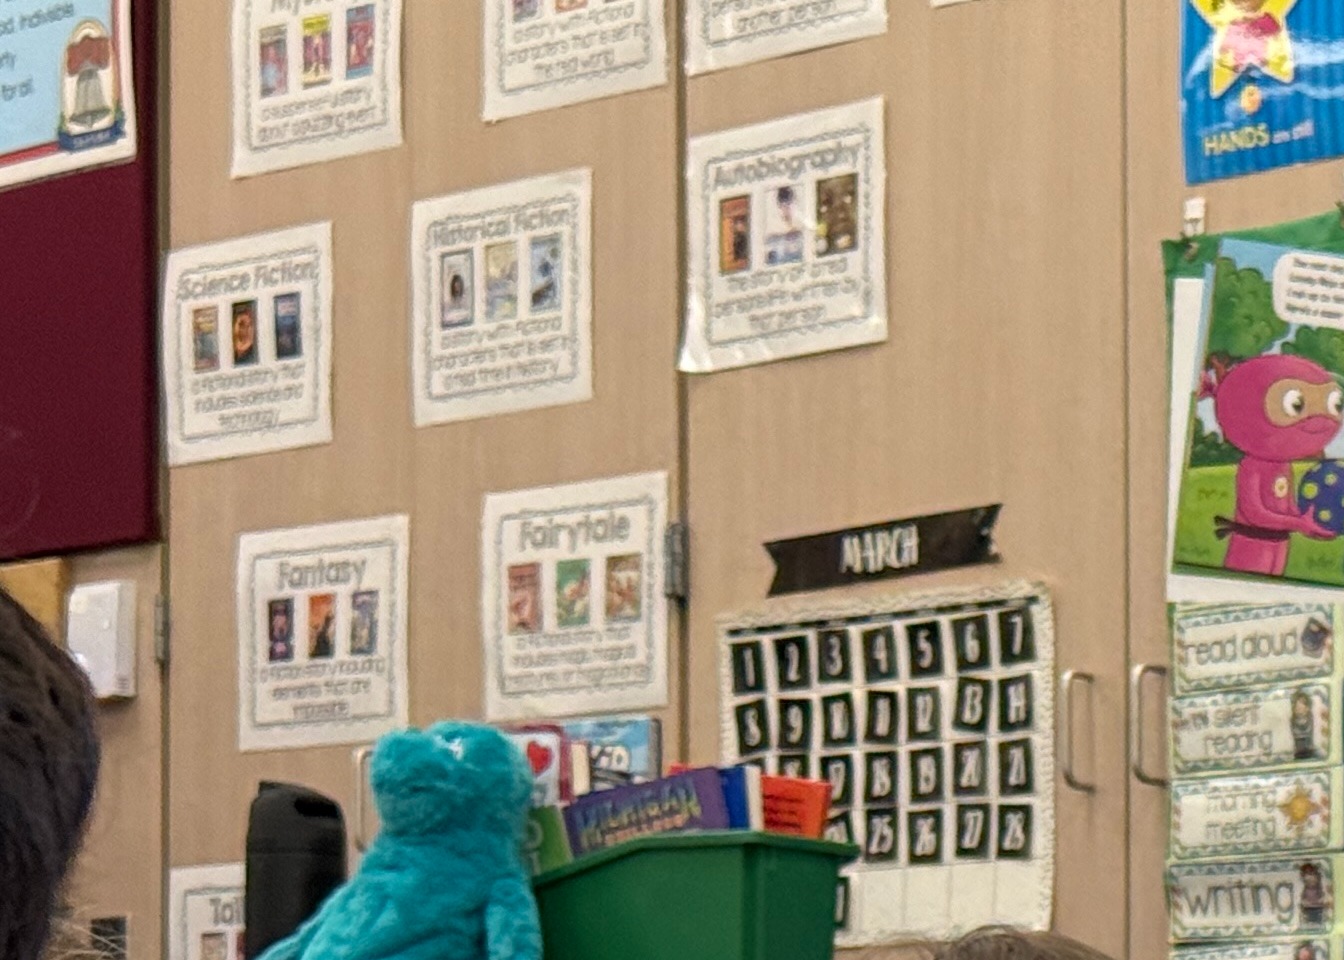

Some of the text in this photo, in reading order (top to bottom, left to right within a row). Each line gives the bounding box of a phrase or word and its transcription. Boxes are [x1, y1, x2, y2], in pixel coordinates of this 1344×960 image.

[1203, 121, 1271, 157] HANDS
[713, 141, 860, 190] Autobiography
[432, 204, 573, 248] Historical Fiction
[178, 258, 319, 298] Science Fiction
[519, 511, 633, 554] Fairytale
[839, 522, 920, 575] MARCH
[277, 557, 368, 592] Fantasy
[742, 646, 756, 688] 1
[785, 642, 801, 683] 2
[825, 634, 844, 677] 3
[873, 632, 890, 675] 4
[916, 627, 934, 669] 5
[964, 620, 981, 664] 6
[1009, 614, 1024, 656] 7
[1183, 631, 1299, 668] read aloud
[745, 706, 762, 748] 8
[786, 703, 803, 744] 9
[961, 683, 984, 726] 13
[1006, 682, 1027, 724] 14
[1203, 728, 1274, 758] reading
[871, 756, 892, 798] 18
[916, 754, 937, 796] 19
[1205, 785, 1277, 816] morning
[868, 813, 894, 855] 25
[914, 816, 937, 857] 26
[960, 809, 985, 851] 27
[1002, 810, 1027, 852] 28
[1205, 813, 1277, 842] meeting
[1182, 877, 1295, 925] writing
